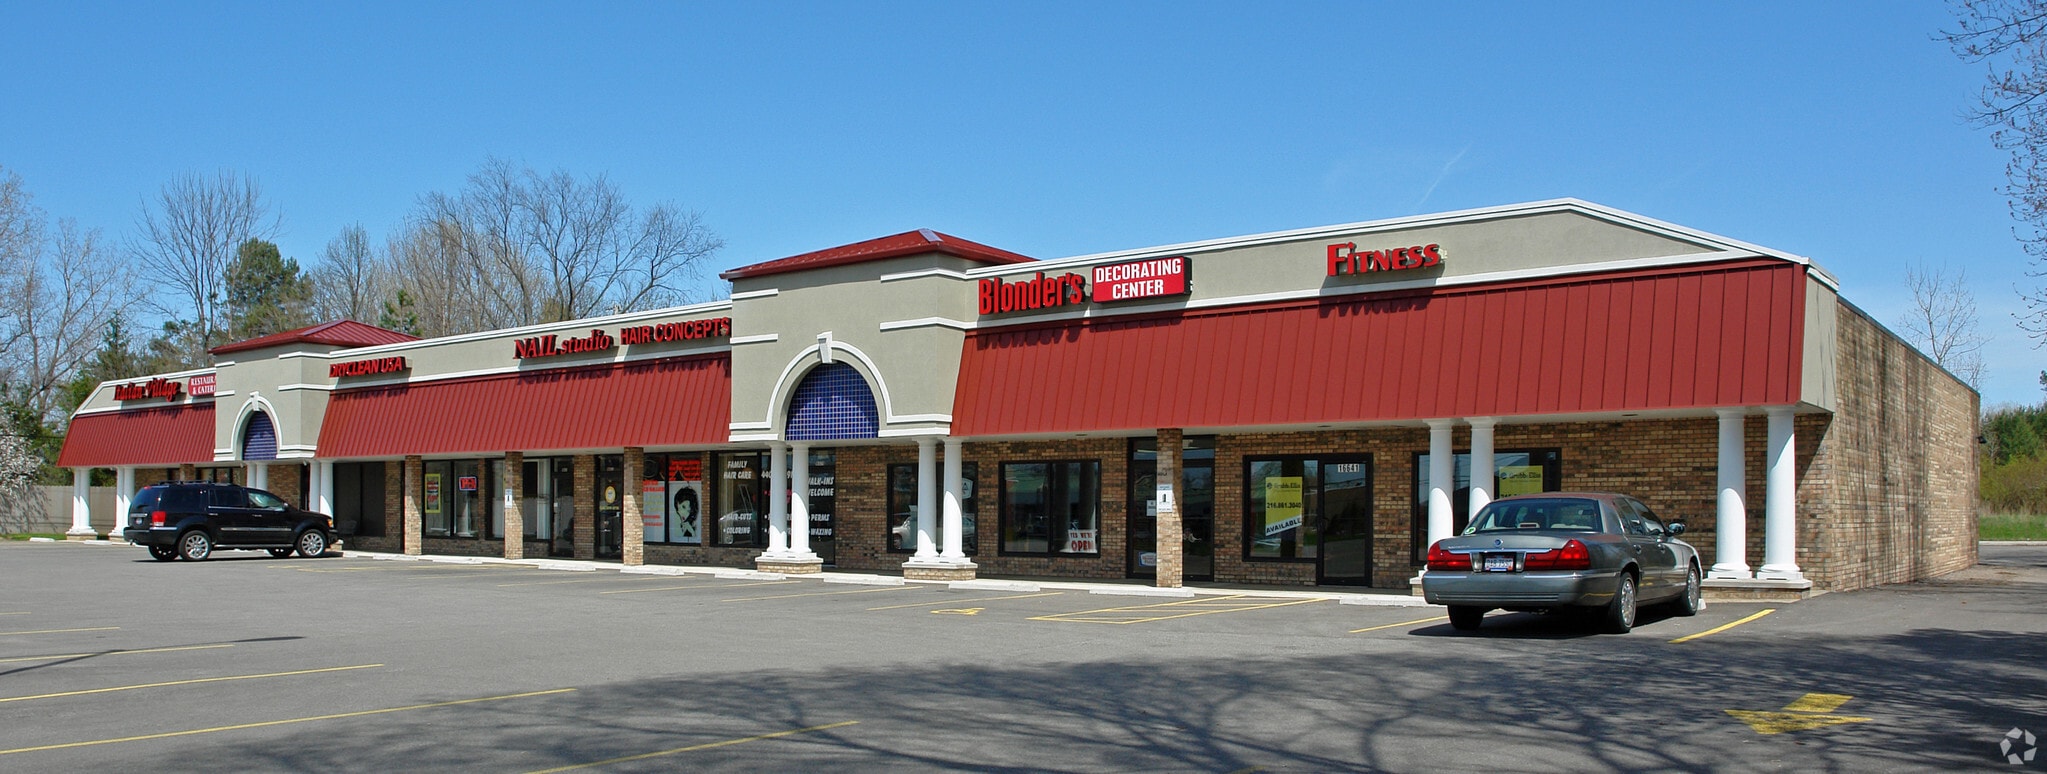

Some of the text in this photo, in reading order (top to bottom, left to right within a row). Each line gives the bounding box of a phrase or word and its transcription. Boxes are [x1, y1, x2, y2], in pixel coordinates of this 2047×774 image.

[1096, 259, 1182, 283] DECORATING
[979, 272, 1084, 315] Blonder's
[1112, 280, 1165, 299] CENTER
[620, 317, 730, 346] HAIR CONCEPTS
[512, 329, 611, 360] NAIL studio
[329, 356, 404, 378] DRYCLEAN USA
[113, 377, 181, 402] Italian Village
[727, 461, 748, 469] FAMILY
[1338, 464, 1360, 473] 16641
[724, 471, 752, 480] HAIR CARE
[811, 513, 831, 522] PERMS
[726, 526, 751, 535] COLORING
[811, 528, 833, 536] WAXING
[1071, 540, 1094, 551] OPEN
